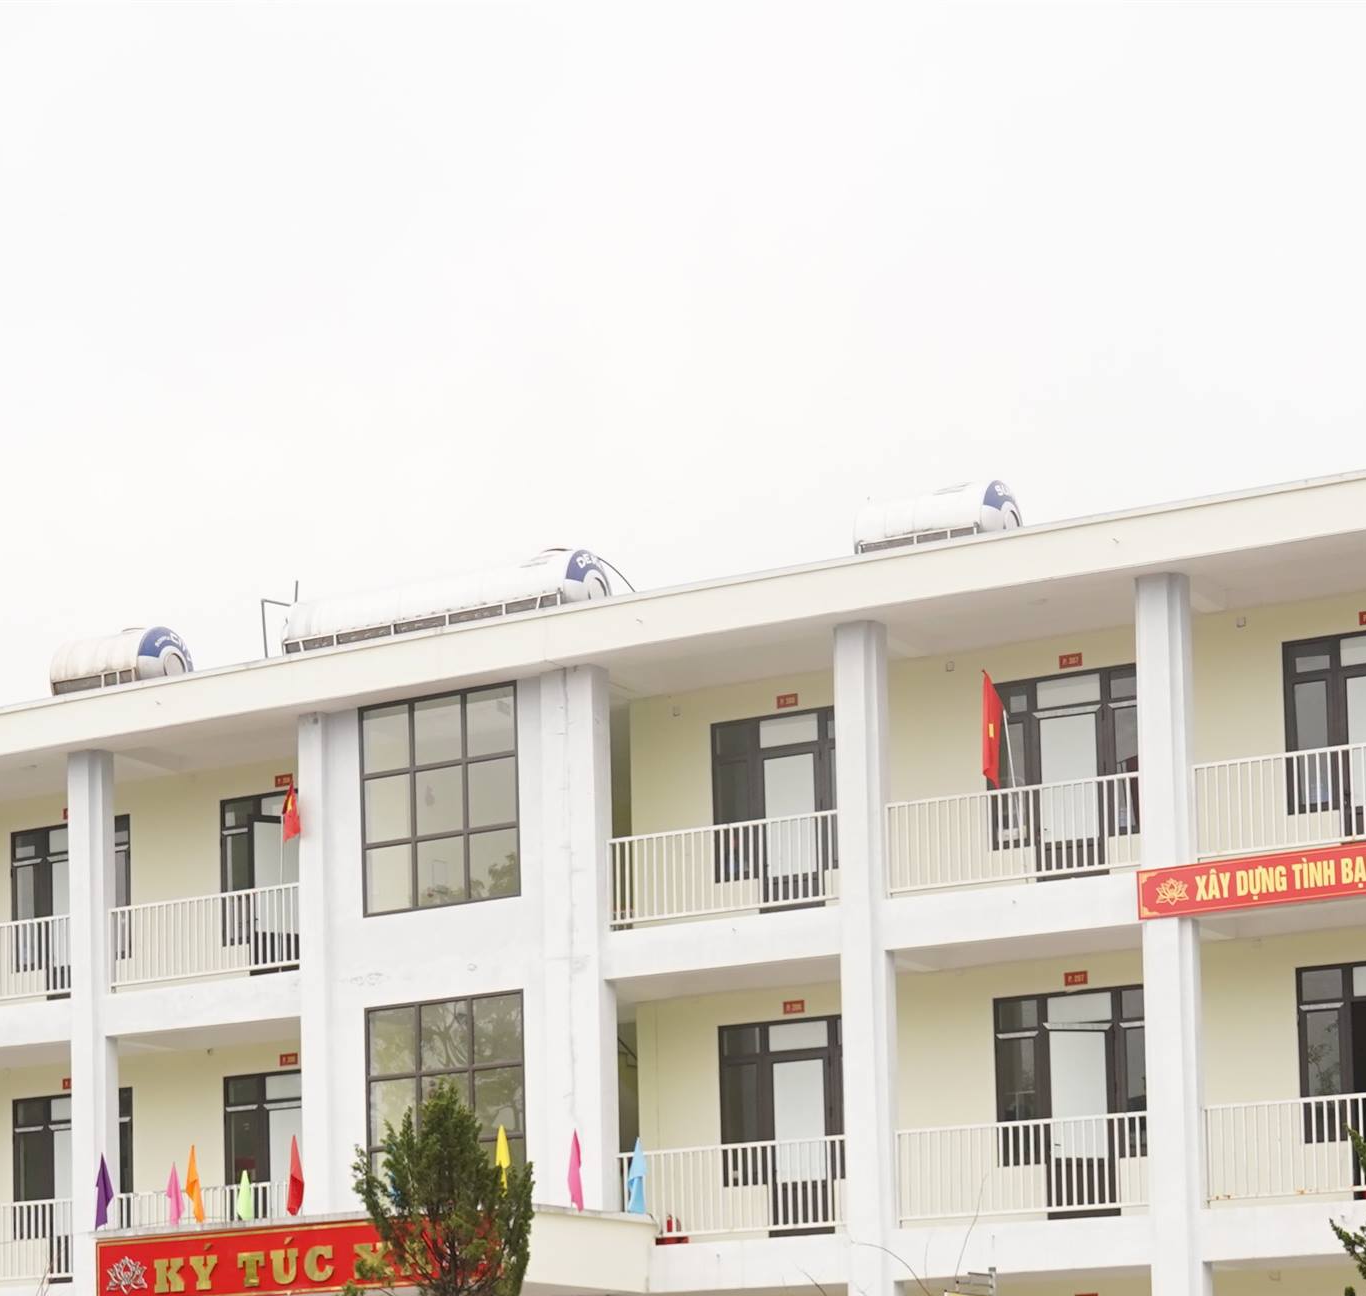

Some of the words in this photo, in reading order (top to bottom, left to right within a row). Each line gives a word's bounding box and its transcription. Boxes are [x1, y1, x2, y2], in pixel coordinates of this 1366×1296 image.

[1195, 868, 1230, 901] XÂY
[1236, 865, 1287, 900] DỰNG
[1292, 857, 1335, 889] TÌNH
[154, 1243, 217, 1293] KÝ
[237, 1236, 334, 1288] TÚC
